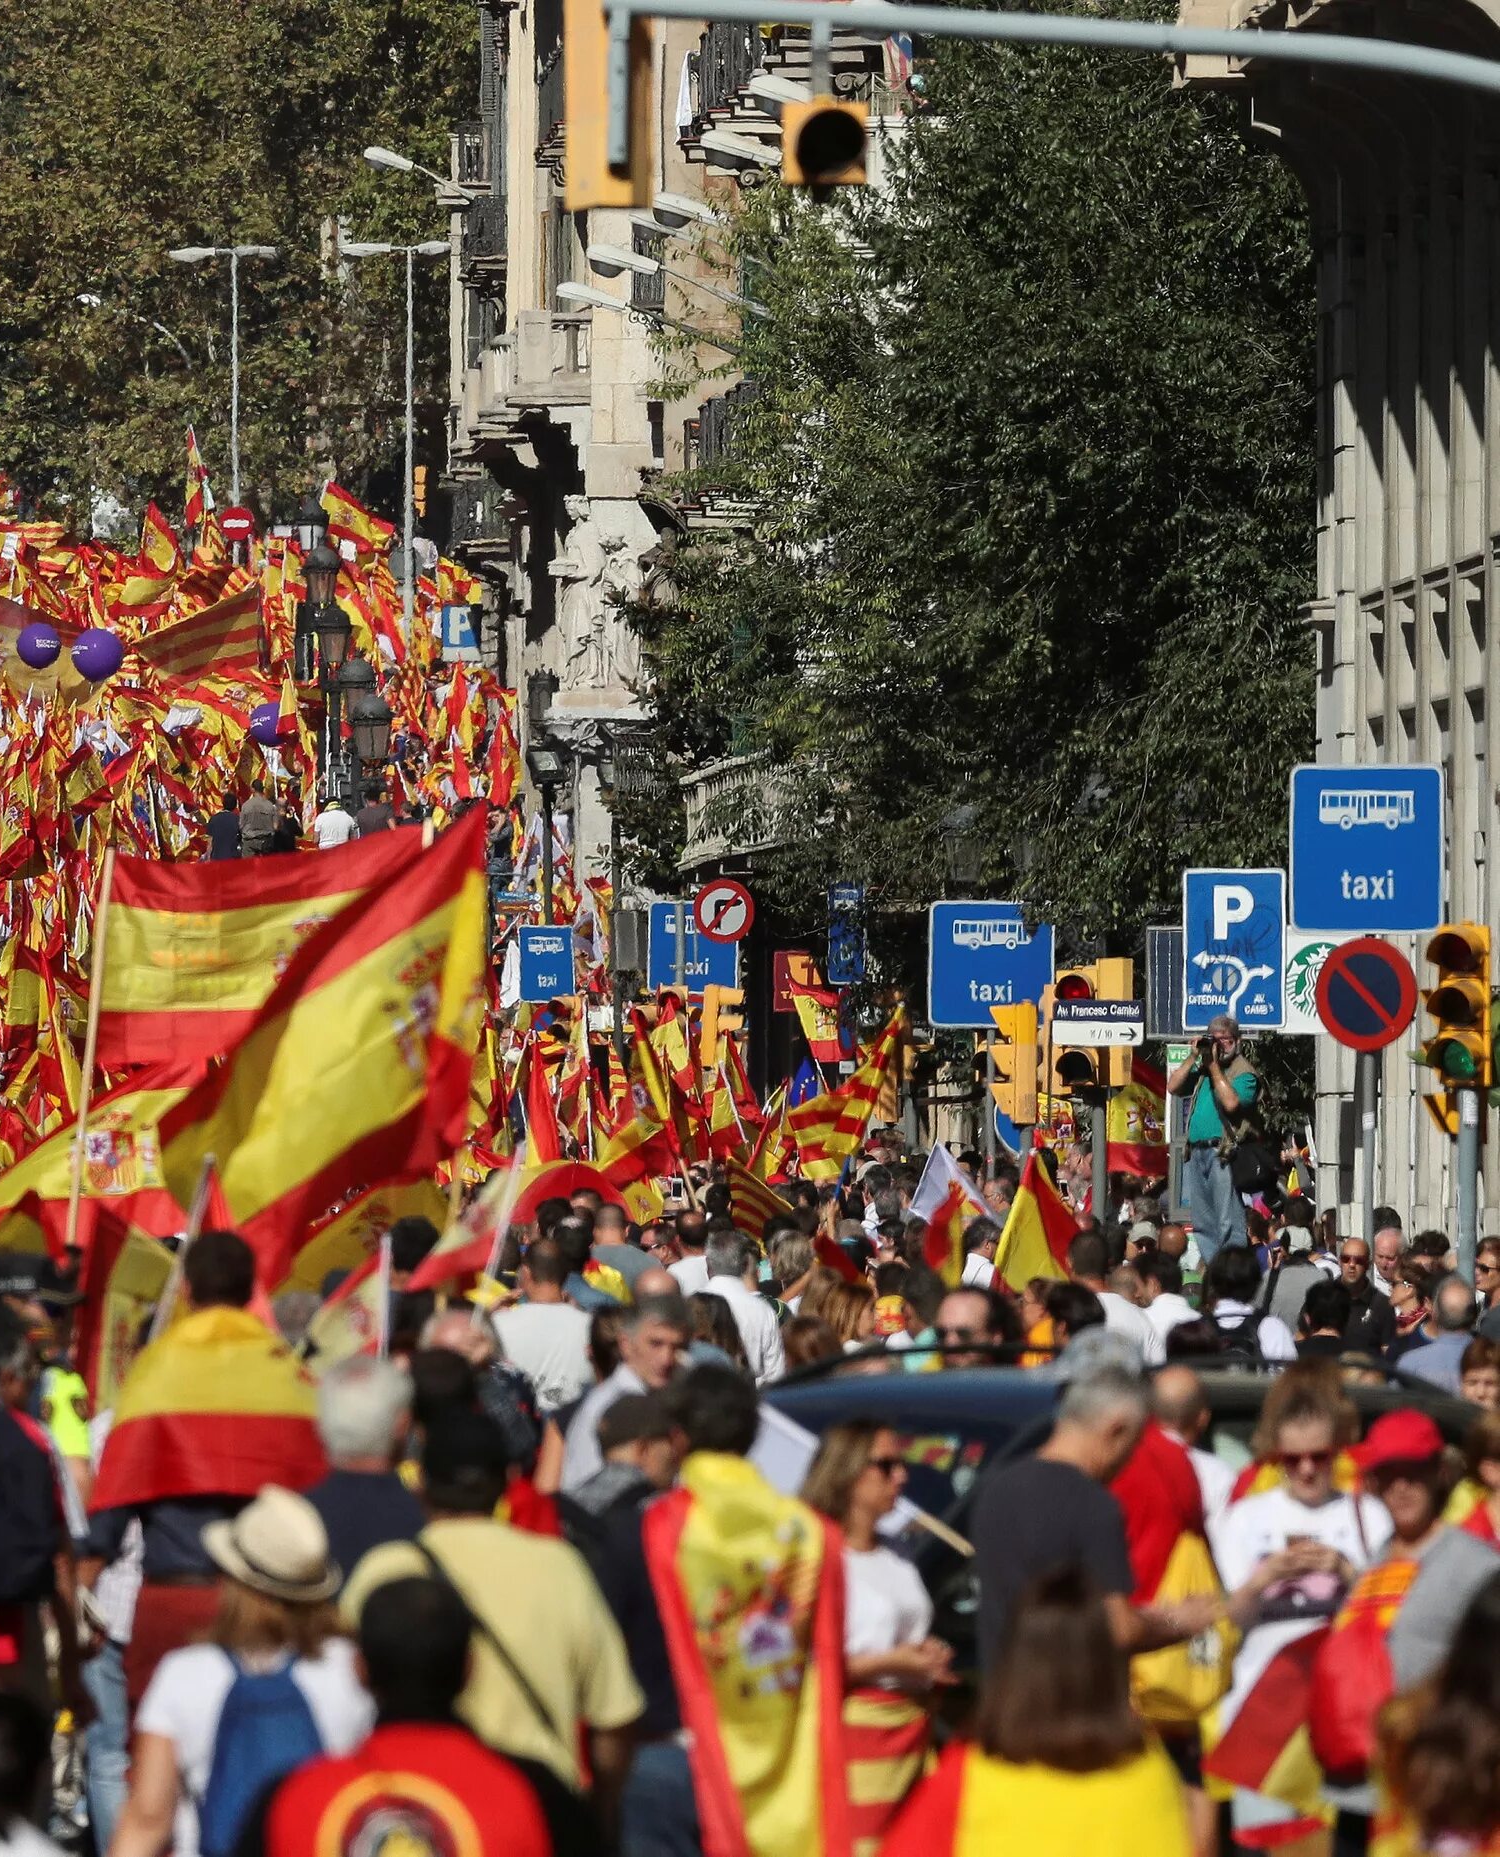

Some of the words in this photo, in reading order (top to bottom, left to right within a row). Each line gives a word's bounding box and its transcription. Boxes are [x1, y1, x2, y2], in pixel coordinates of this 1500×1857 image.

[449, 606, 471, 645] P
[1341, 869, 1394, 900] taxi
[1213, 885, 1254, 940] P
[684, 958, 710, 975] axi
[537, 974, 558, 988] taxi
[969, 979, 1013, 1003] taxi
